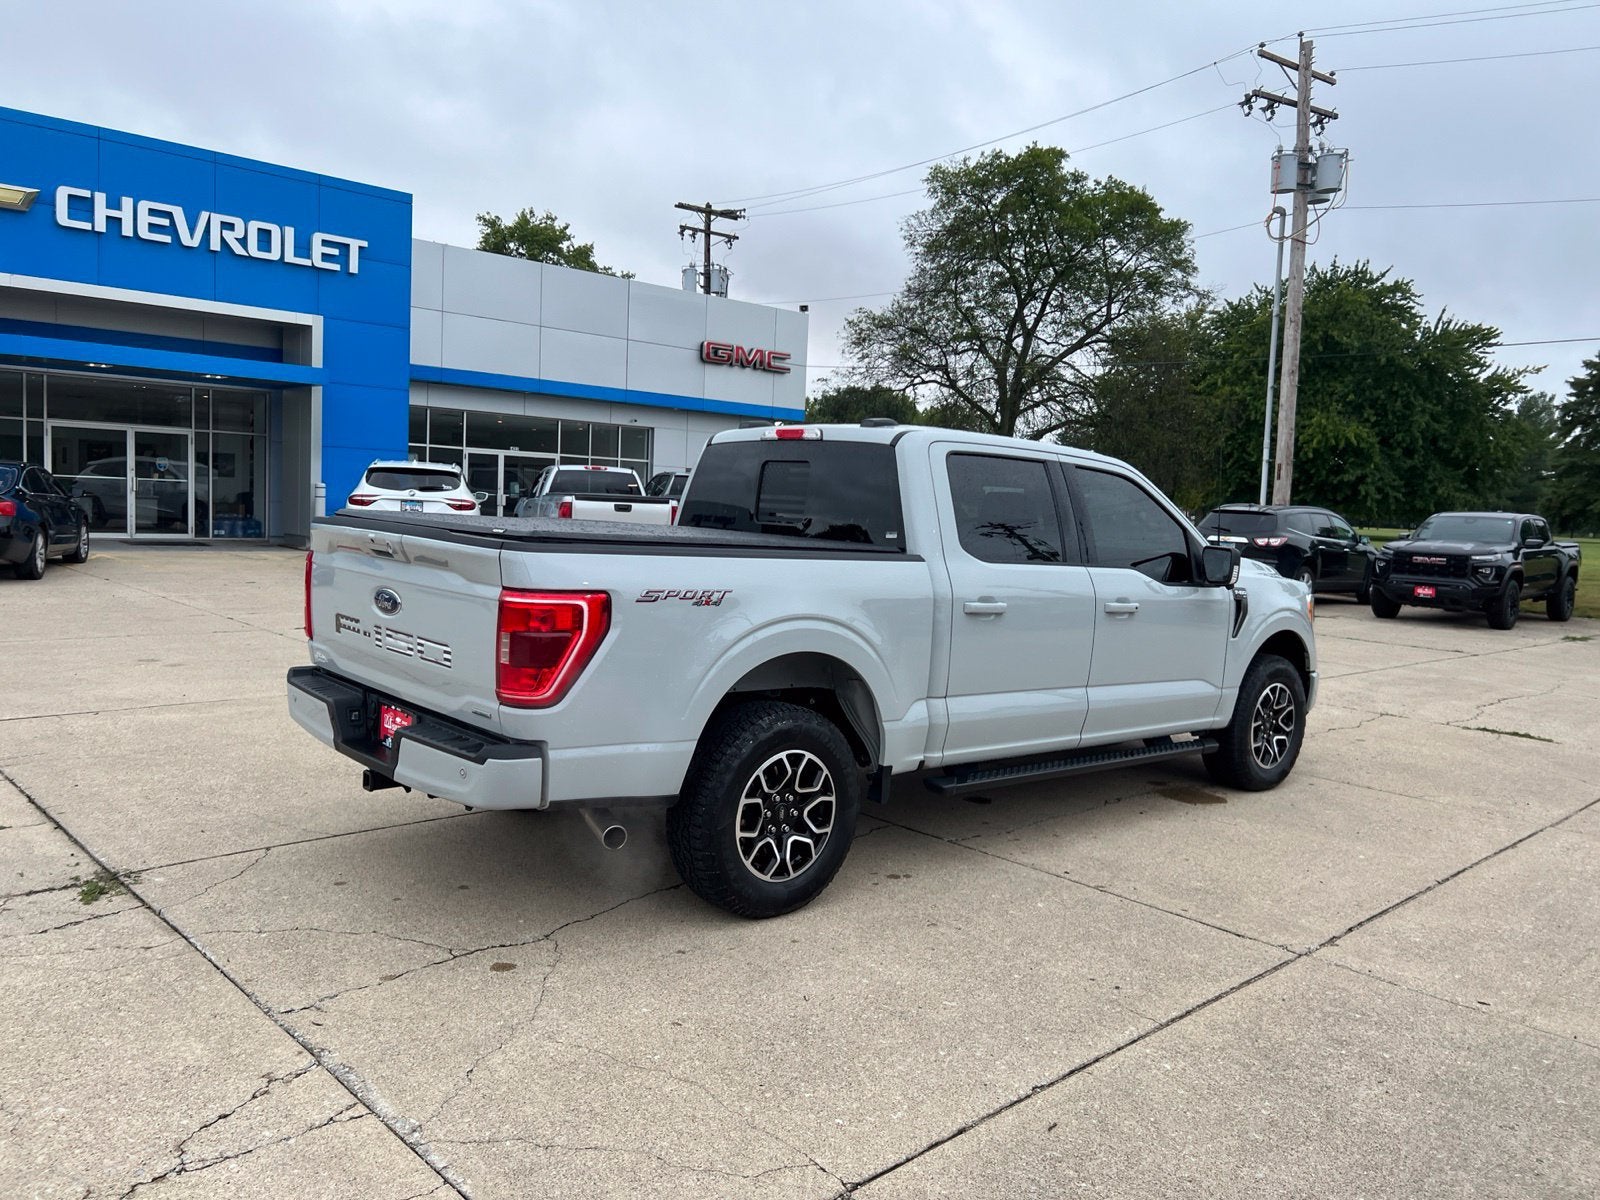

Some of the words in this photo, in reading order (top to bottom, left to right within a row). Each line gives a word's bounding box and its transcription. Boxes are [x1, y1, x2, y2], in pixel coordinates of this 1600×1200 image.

[55, 185, 368, 274] CHEVROLET
[700, 341, 791, 374] GMC
[635, 589, 733, 603] SPORT
